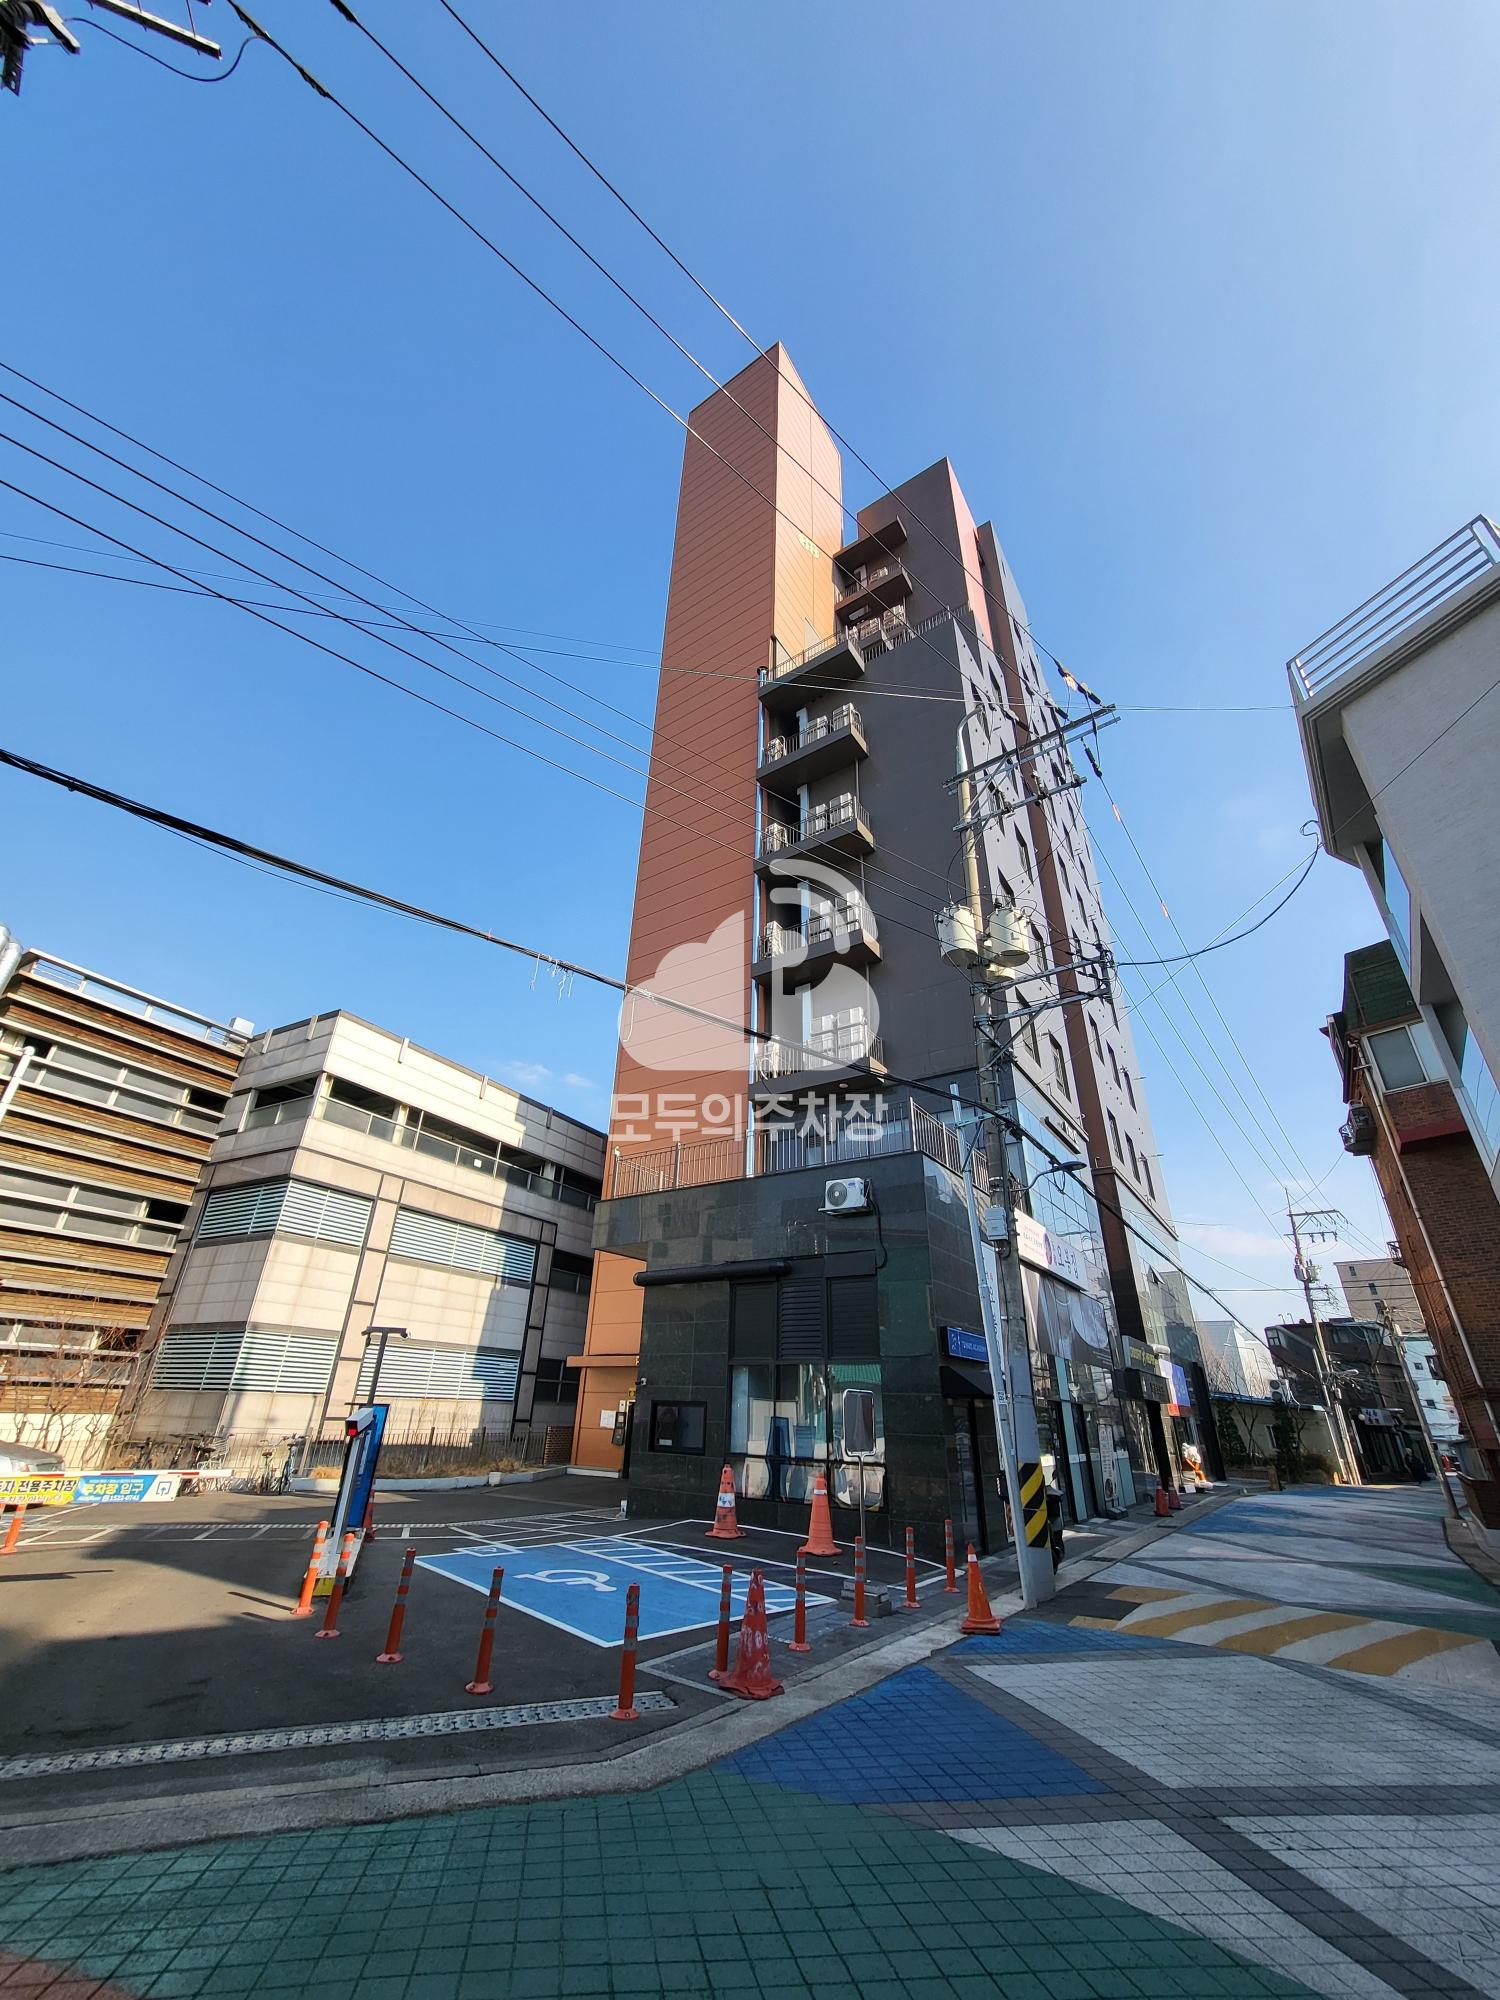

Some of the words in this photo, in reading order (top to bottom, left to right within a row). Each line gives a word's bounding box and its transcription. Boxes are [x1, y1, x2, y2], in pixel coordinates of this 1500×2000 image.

[17, 1480, 79, 1493] 전용주차장
[85, 1482, 118, 1495] 주차장
[119, 1483, 144, 1494] 입구
